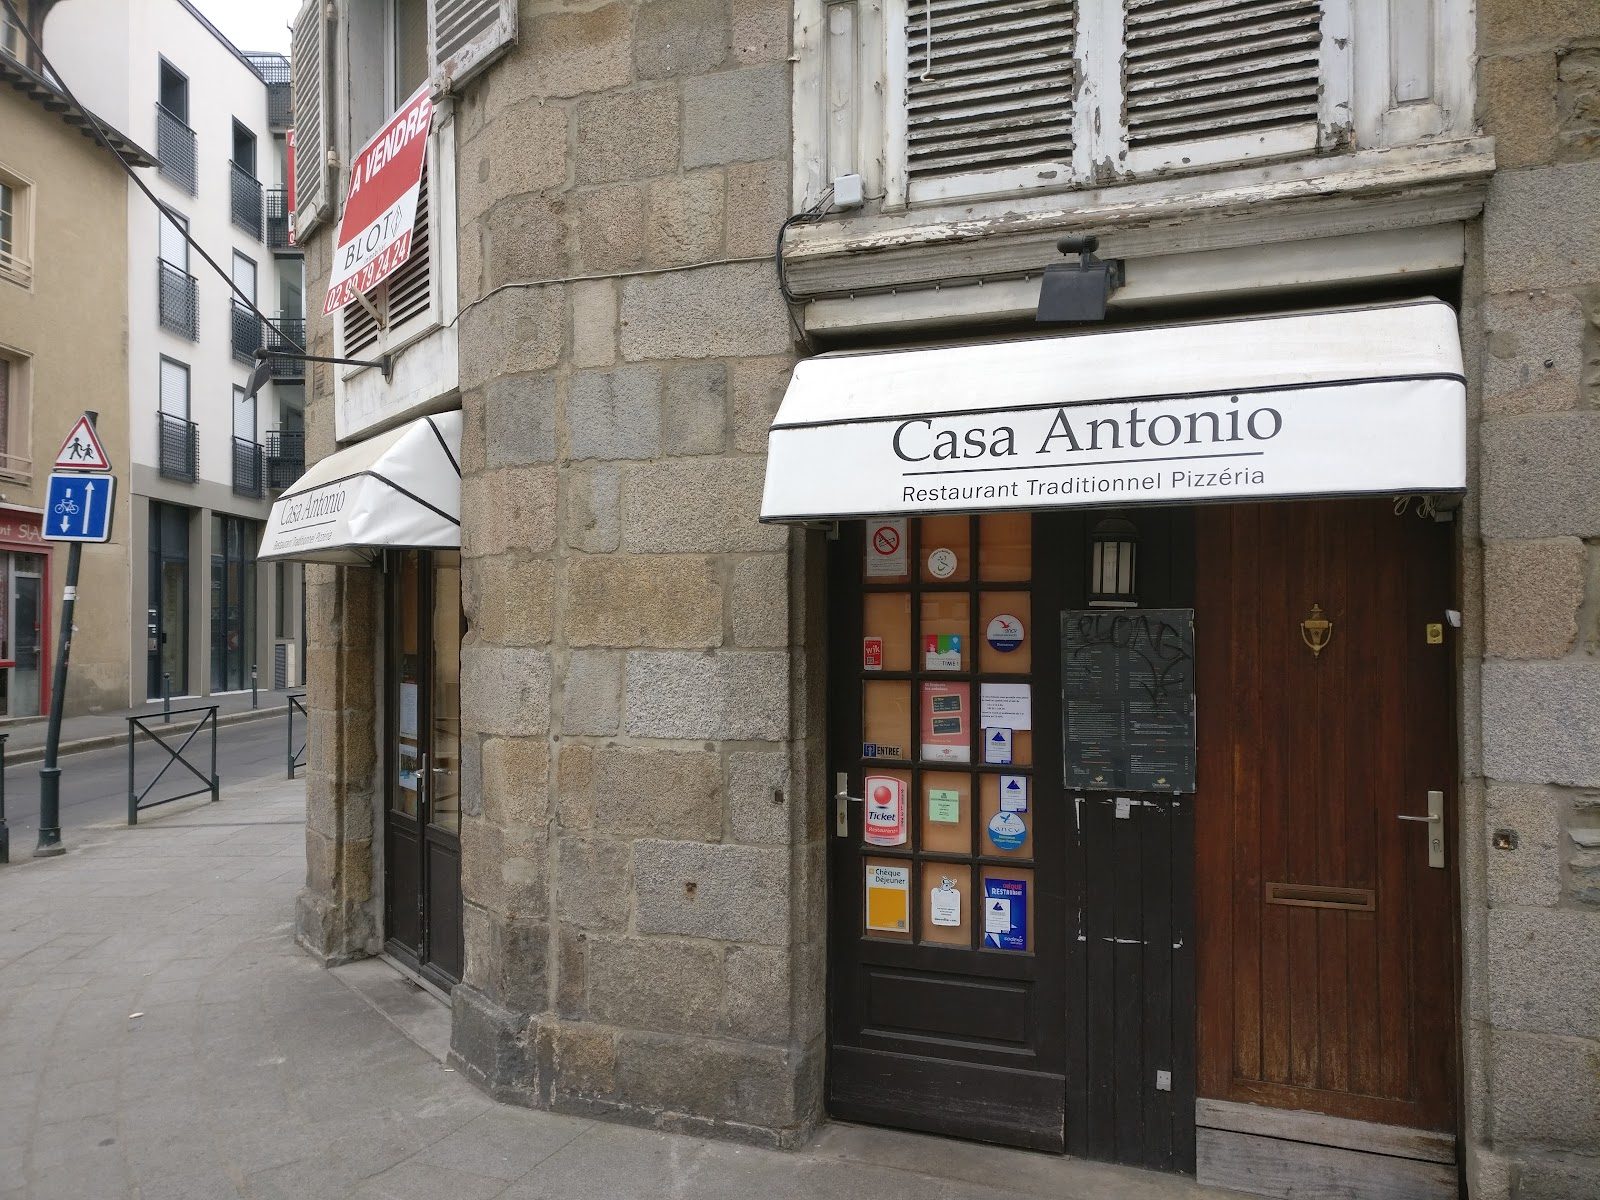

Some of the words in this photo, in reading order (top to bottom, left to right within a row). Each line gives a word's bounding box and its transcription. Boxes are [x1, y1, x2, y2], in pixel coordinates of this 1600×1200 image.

[350, 165, 362, 199] A
[364, 97, 430, 184] VENDRE
[344, 211, 393, 270] BLOT
[892, 418, 1018, 463] Casa
[1035, 395, 1283, 454] Antonio
[902, 480, 1018, 502] Restaurant
[1026, 473, 1161, 496] Traditionnel
[1171, 468, 1265, 488] Pizzéria
[280, 498, 303, 526] Casa
[305, 483, 345, 519] Antonio
[877, 746, 900, 756] ENTREE
[869, 811, 896, 822] Ticket
[875, 876, 906, 885] Déjeuner
